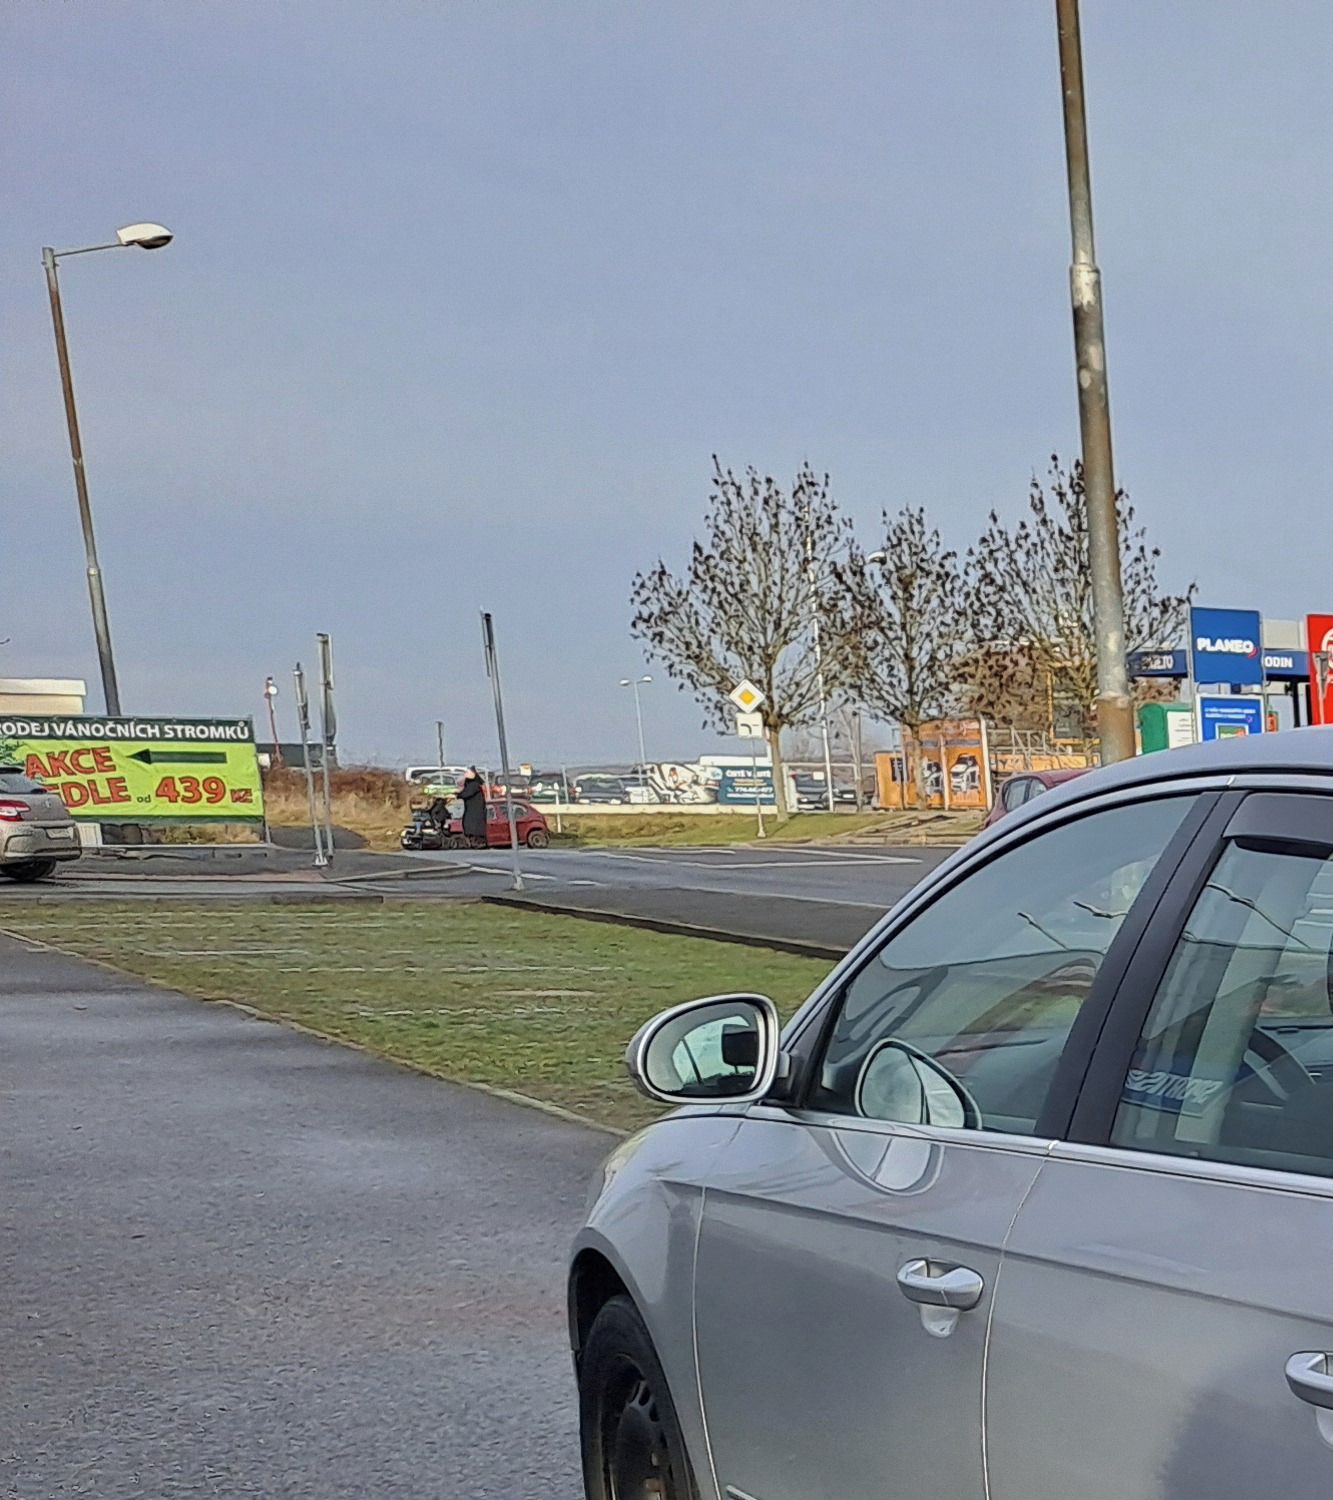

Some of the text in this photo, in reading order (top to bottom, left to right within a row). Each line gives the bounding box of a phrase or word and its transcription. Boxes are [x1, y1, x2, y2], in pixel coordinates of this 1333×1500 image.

[1197, 637, 1254, 653] PLANEO
[1264, 656, 1293, 669] ODIN
[0, 720, 250, 740] ODEJ VÁNOČNÍCH STROMKŮ
[25, 746, 117, 779] AKCE
[43, 776, 132, 808] DLE
[137, 794, 151, 804] od
[155, 776, 227, 804] 439
